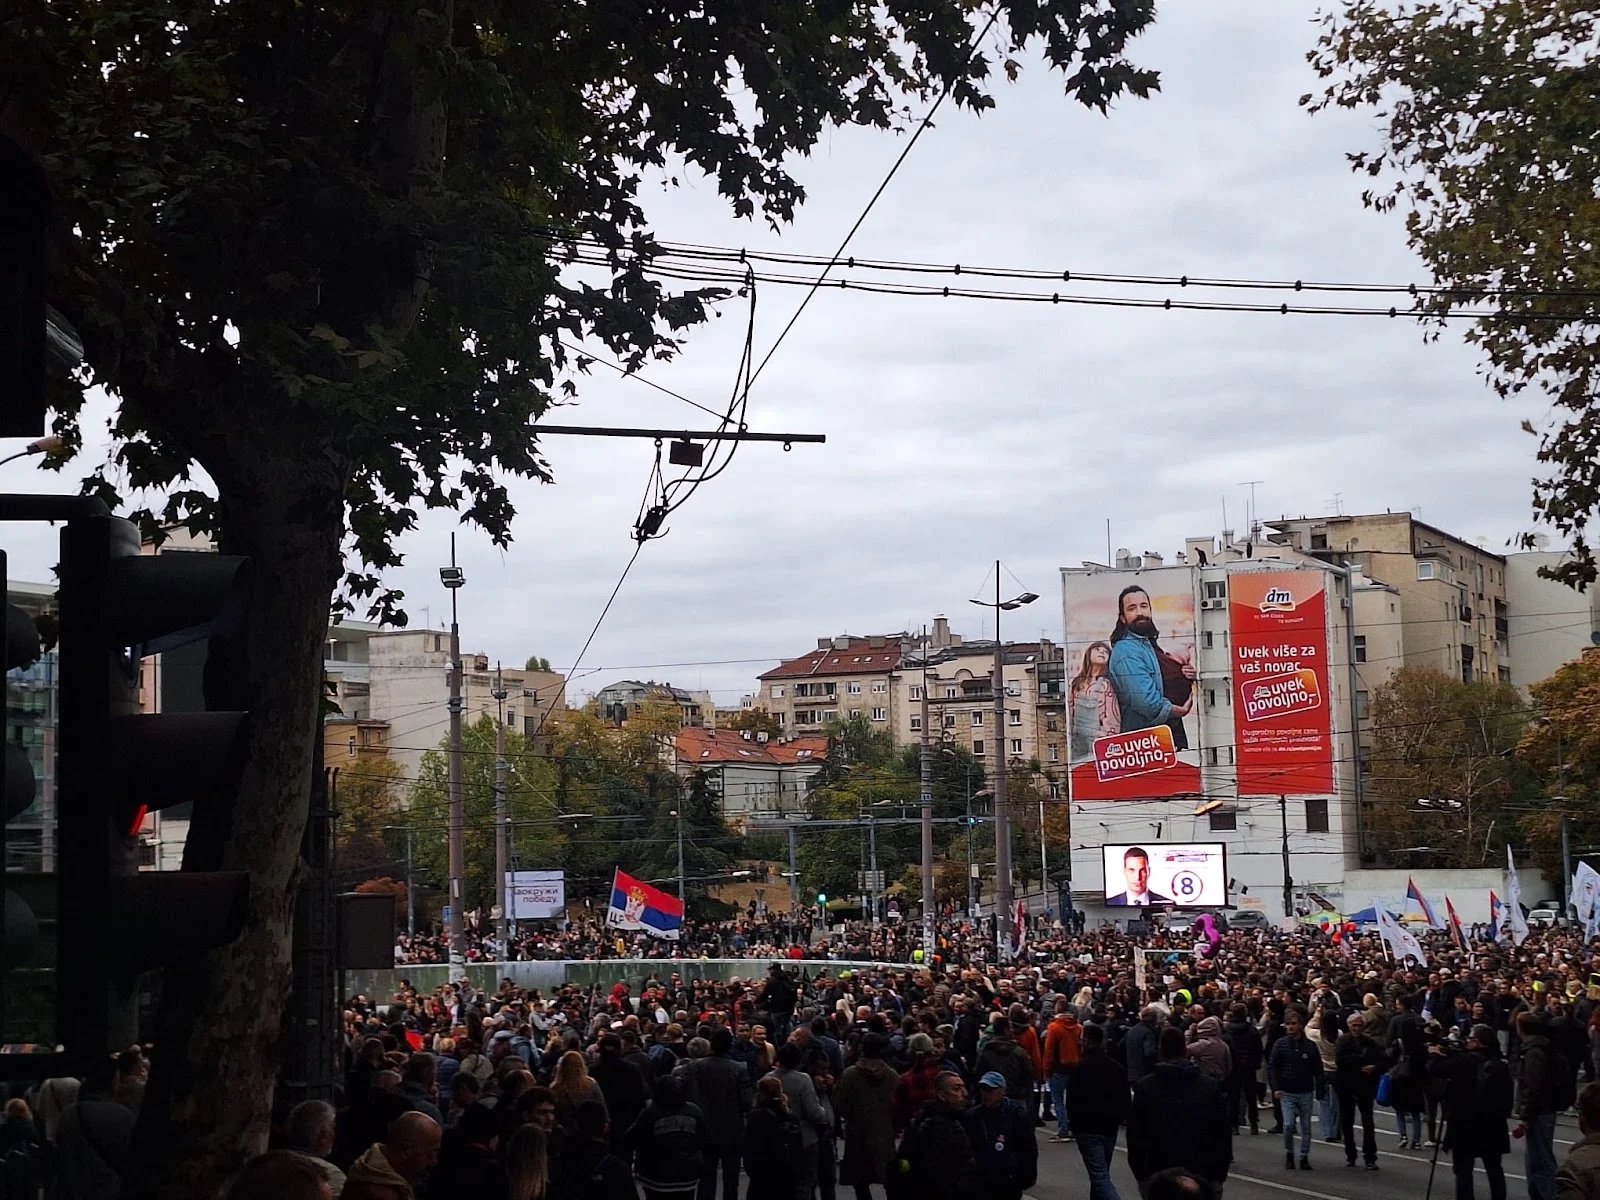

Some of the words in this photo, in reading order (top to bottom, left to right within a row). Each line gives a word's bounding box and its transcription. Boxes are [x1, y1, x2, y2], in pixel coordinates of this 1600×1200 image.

[1266, 589, 1290, 603] dm
[1238, 644, 1269, 659] Uvek
[1272, 644, 1298, 658] više
[1300, 645, 1316, 657] za
[1239, 660, 1261, 673] vaš
[1264, 661, 1301, 673] novac
[1271, 676, 1305, 694] uvek
[1124, 734, 1160, 752] uvek
[1180, 877, 1194, 895] 8
